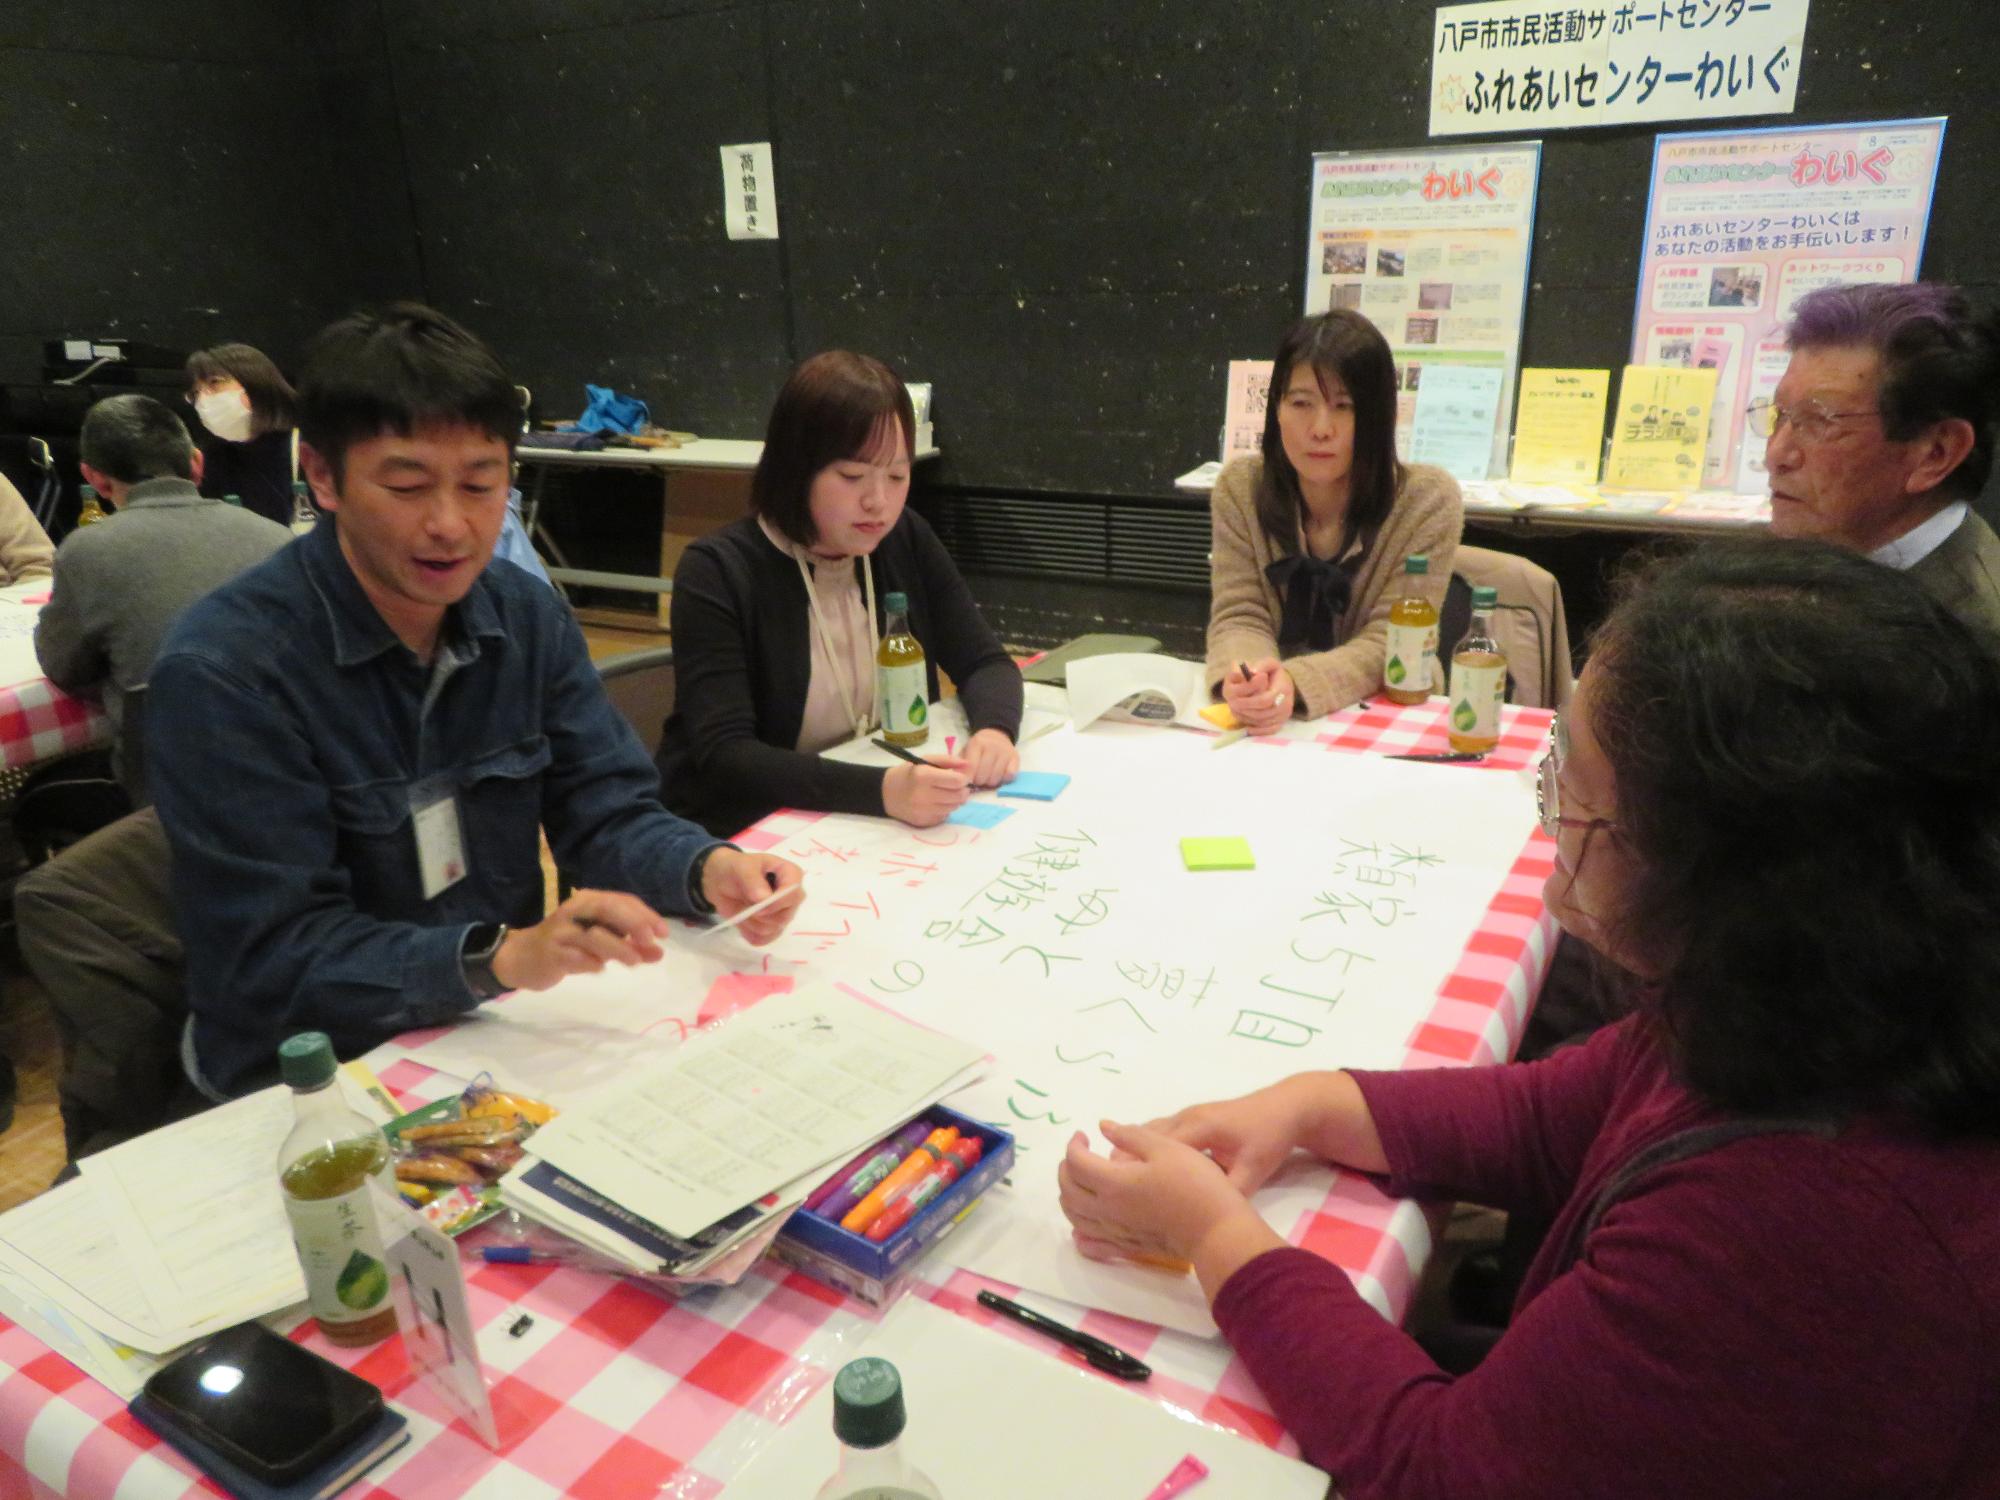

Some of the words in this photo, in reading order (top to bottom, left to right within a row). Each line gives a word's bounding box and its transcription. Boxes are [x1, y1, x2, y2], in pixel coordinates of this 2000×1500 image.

[1439, 0, 1772, 53] 八戸市市民活動サポートセンター
[1465, 46, 1790, 115] ふれあいセンターわいぐ
[1656, 210, 1860, 238] ふれあいセンターわいぐは
